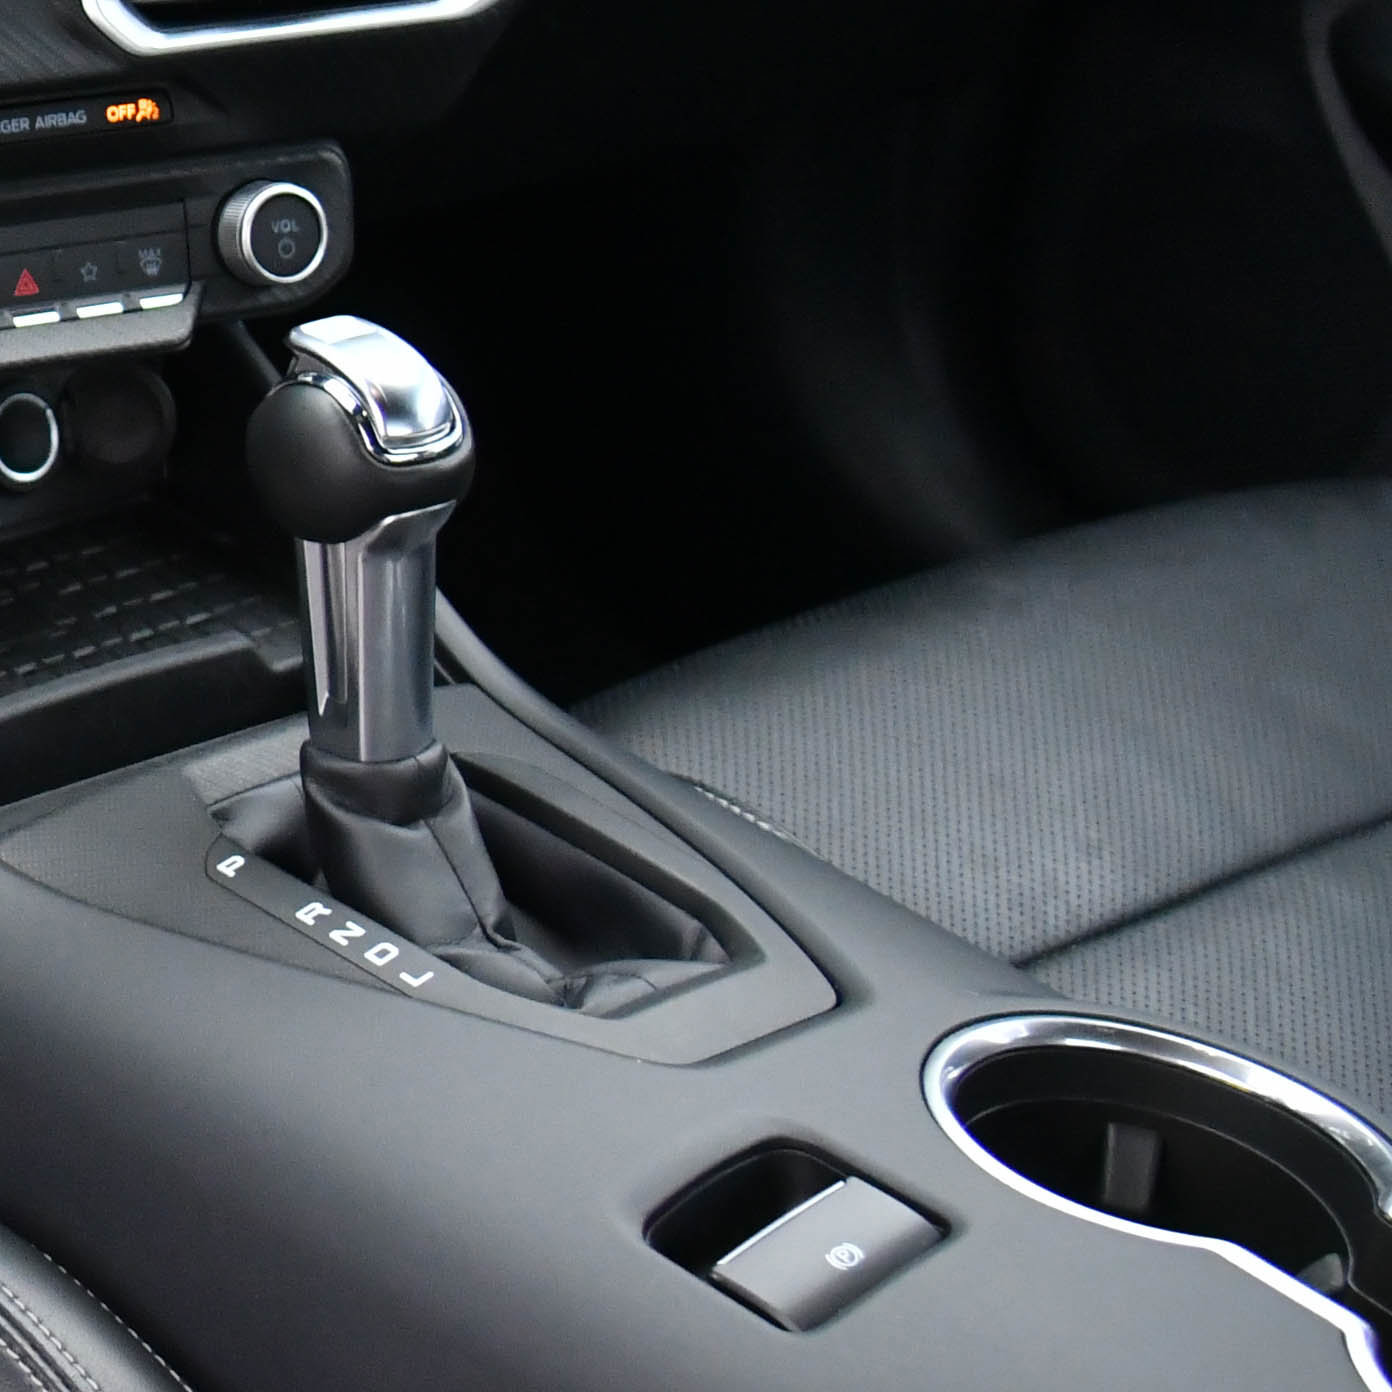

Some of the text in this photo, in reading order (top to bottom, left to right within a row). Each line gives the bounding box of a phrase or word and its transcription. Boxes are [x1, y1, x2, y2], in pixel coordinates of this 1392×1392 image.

[35, 109, 88, 131] AIRBAG
[105, 103, 136, 123] OFF
[271, 218, 300, 234] VOL
[216, 855, 434, 987] P R N D L
